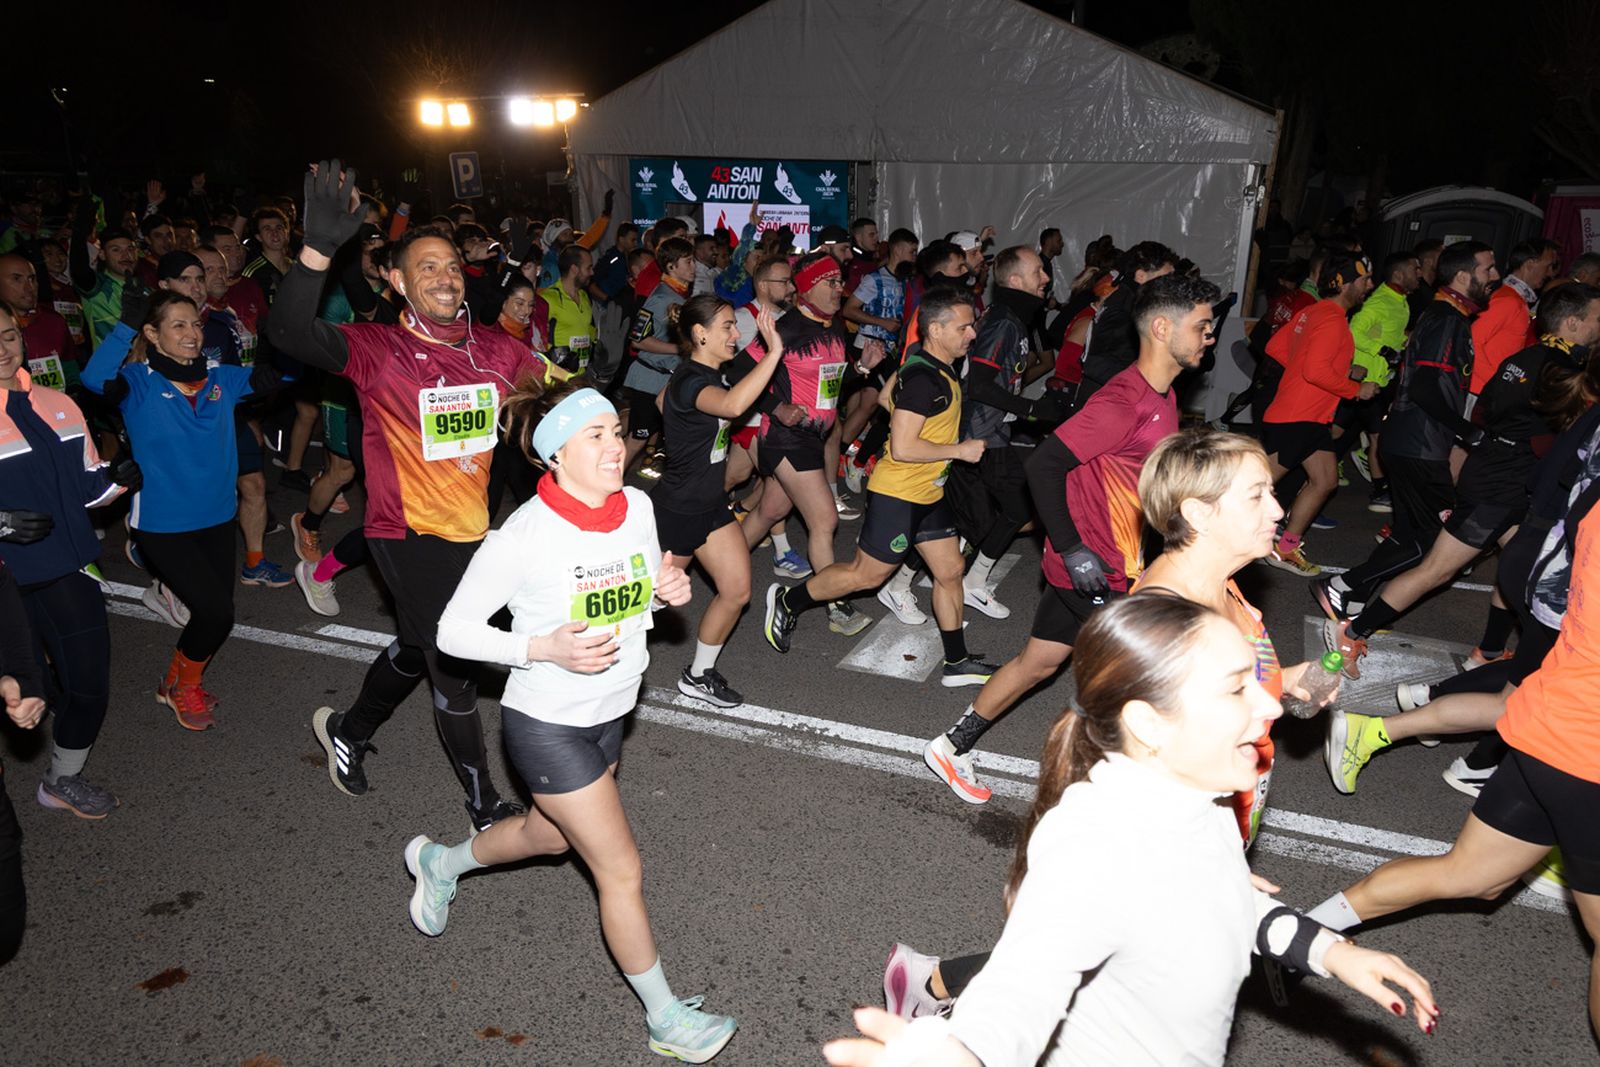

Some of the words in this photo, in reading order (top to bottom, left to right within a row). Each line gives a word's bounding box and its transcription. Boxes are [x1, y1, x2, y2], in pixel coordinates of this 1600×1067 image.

[731, 166, 762, 183] SAN
[678, 182, 689, 195] 43
[707, 179, 761, 200] ANTÓN
[781, 184, 794, 198] 43
[438, 394, 459, 403] NOCHE
[461, 393, 470, 401] DE
[429, 405, 445, 413] SAN
[447, 402, 472, 411] ANTÓN
[435, 409, 486, 435] 9590
[587, 566, 615, 578] NOCHE
[616, 563, 624, 573] DE
[577, 581, 596, 592] SAN
[586, 581, 642, 618] 6662
